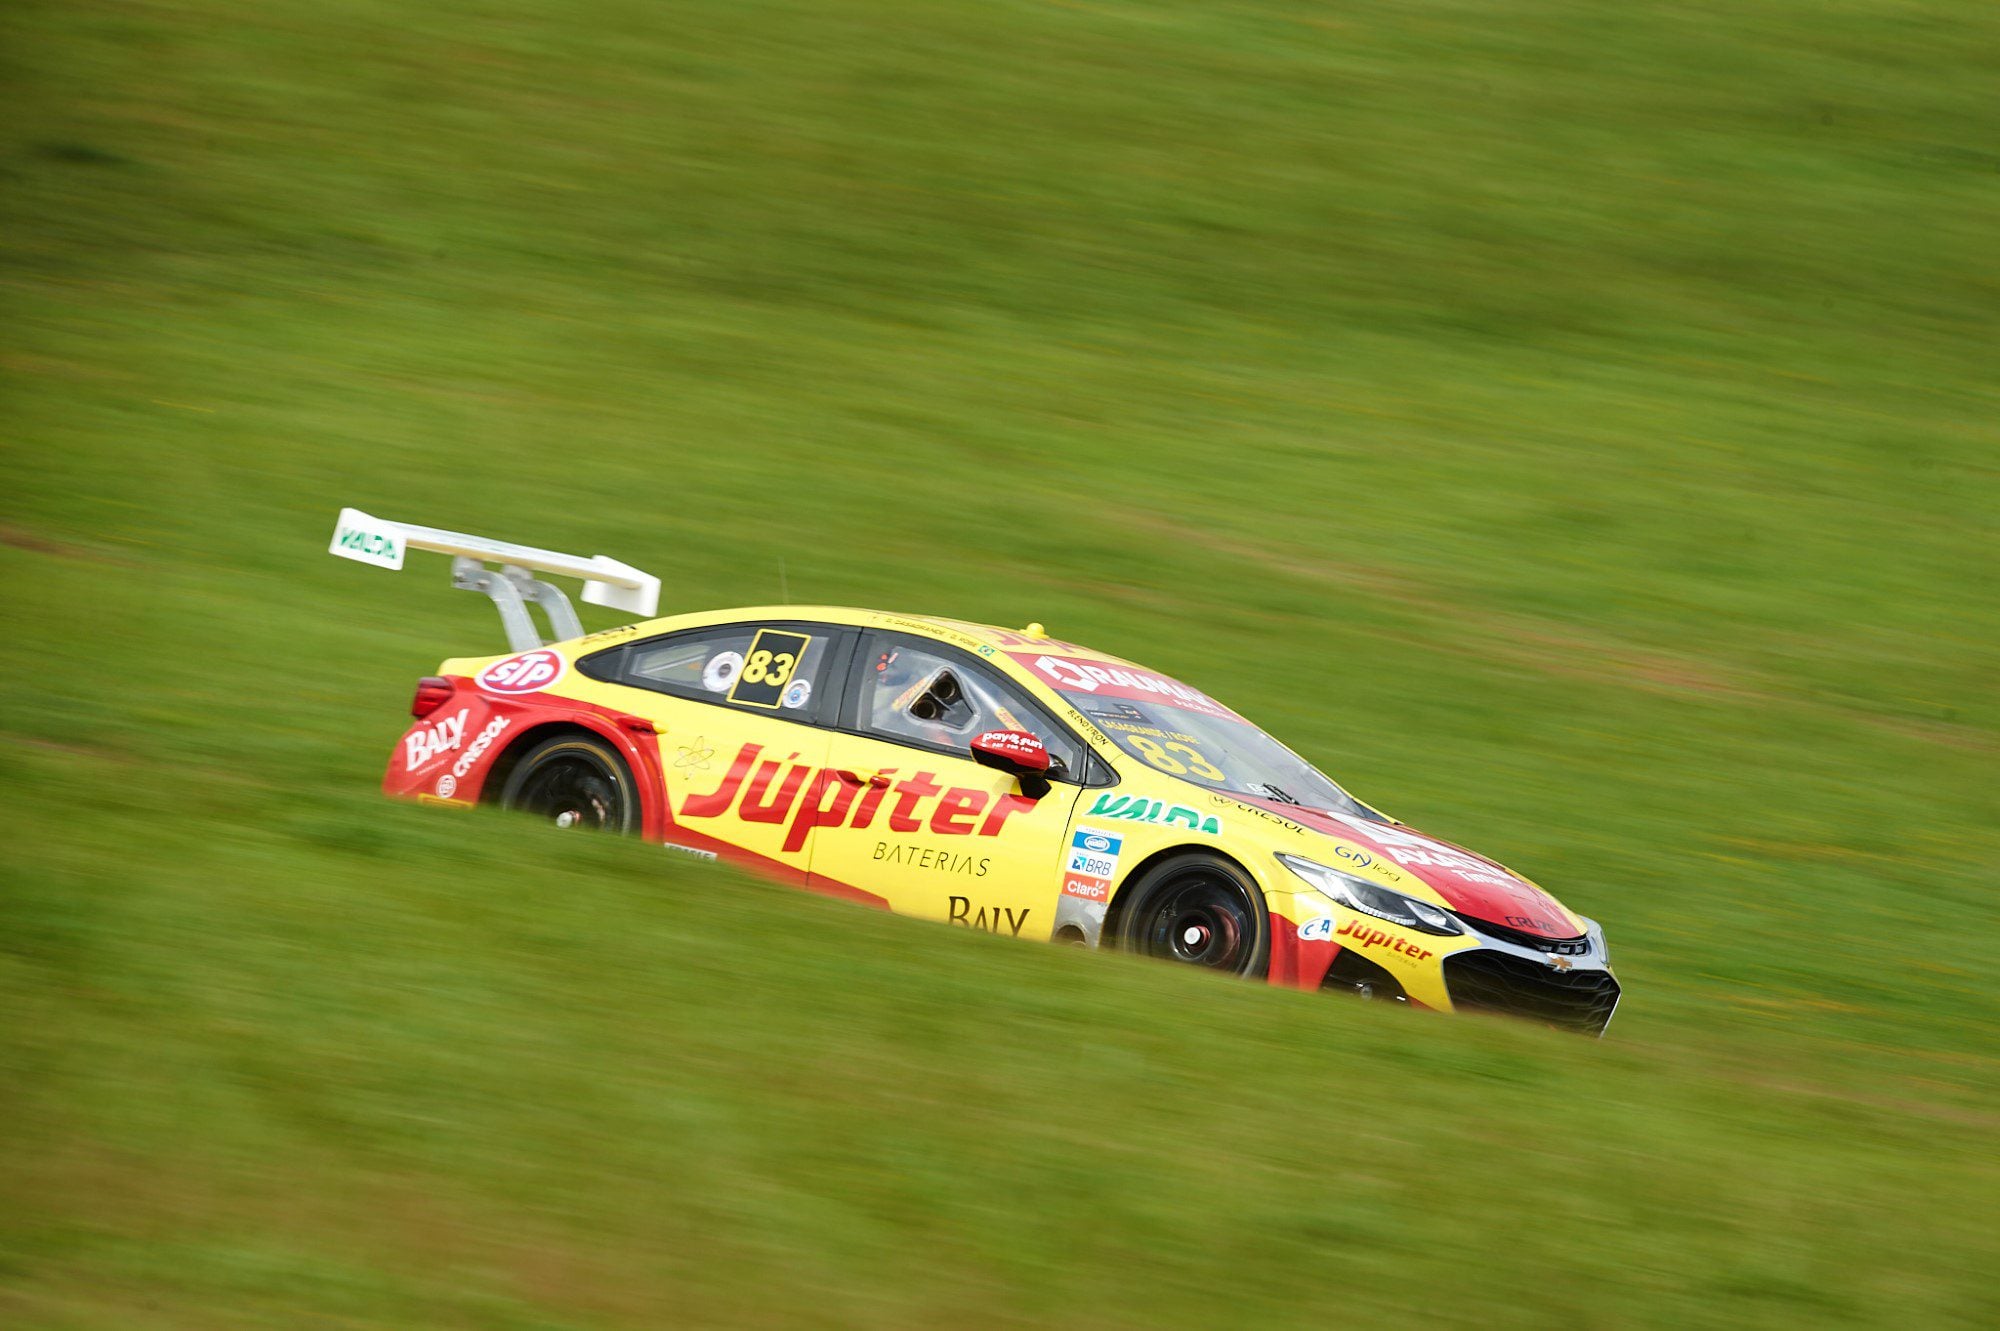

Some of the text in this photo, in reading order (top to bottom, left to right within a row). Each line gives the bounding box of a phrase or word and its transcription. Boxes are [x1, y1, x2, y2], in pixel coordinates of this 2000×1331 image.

[482, 653, 555, 687] STP
[742, 649, 795, 687] 83
[1126, 734, 1226, 782] 83
[678, 742, 1042, 853] Júpiter
[872, 841, 991, 878] BATERIAS
[1085, 858, 1112, 876] BRB
[1067, 879, 1099, 898] Claro
